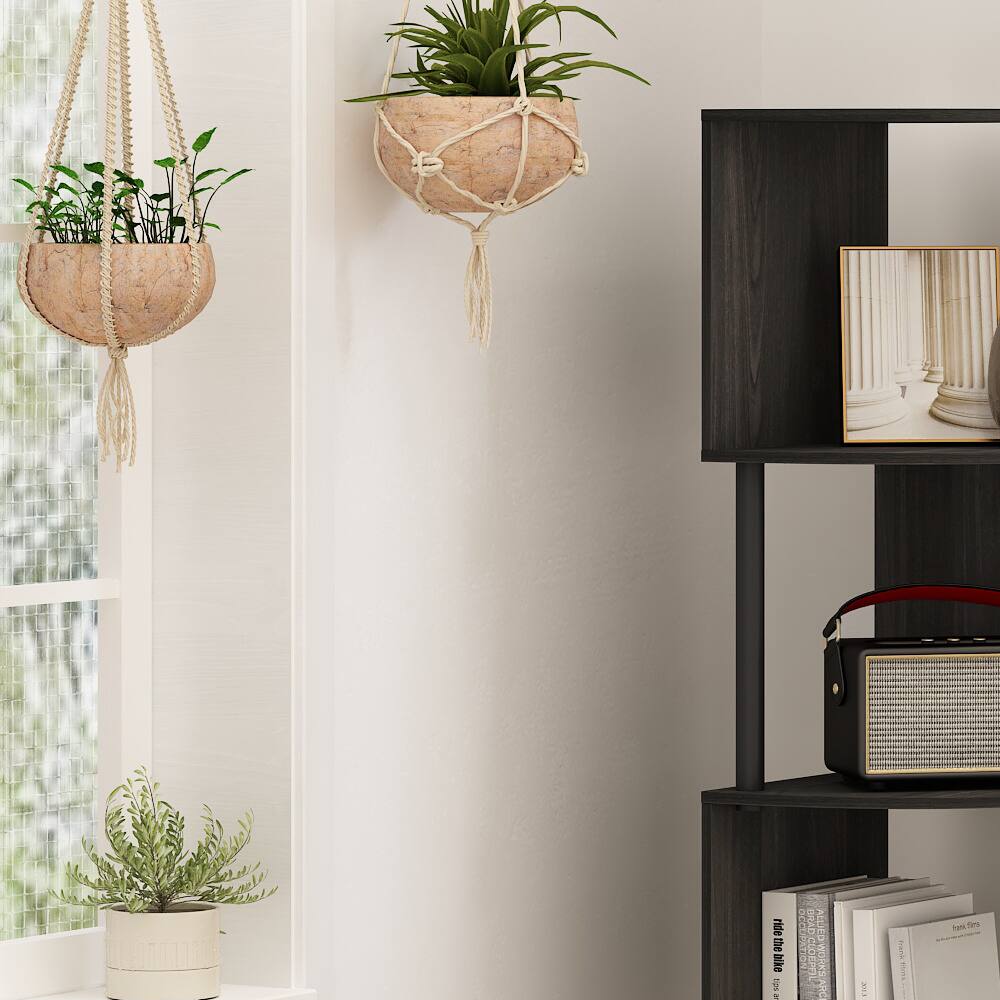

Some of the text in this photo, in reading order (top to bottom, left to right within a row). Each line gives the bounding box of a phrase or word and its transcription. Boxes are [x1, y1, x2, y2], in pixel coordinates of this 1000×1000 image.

[773, 918, 785, 937] ride
[816, 909, 826, 942] ALLIED
[773, 938, 785, 952] the
[798, 908, 807, 970] OCCUPATION
[807, 908, 817, 982] BRAD CLOEPFIL
[773, 953, 785, 973] bike
[817, 943, 827, 977] WORKS
[773, 978, 782, 992] tips
